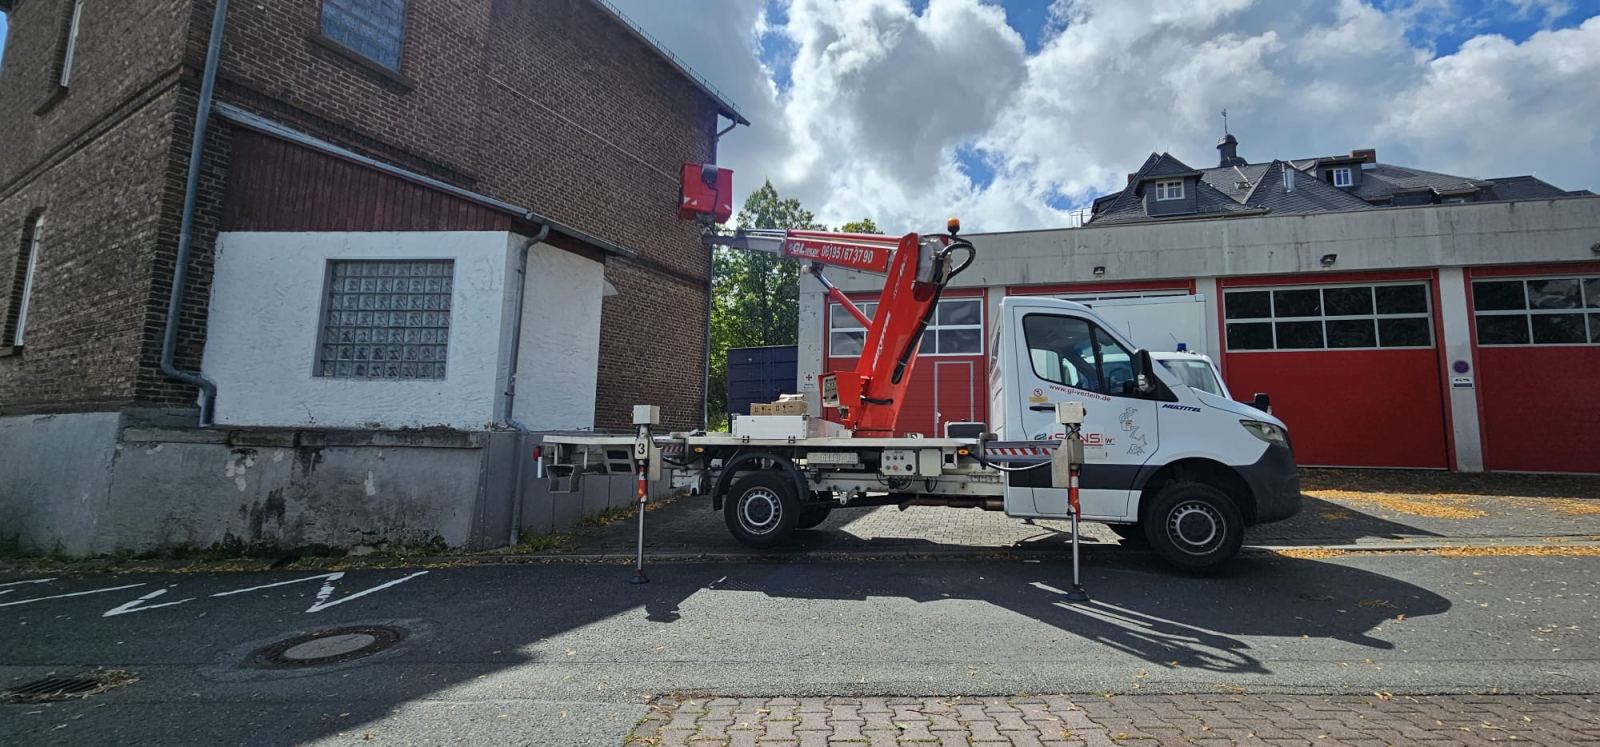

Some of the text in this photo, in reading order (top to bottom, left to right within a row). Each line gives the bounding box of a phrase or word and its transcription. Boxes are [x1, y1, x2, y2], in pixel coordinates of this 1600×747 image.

[1049, 384, 1111, 401] www.gl-verleih.de
[1162, 404, 1201, 412] MULTITEL
[1054, 432, 1101, 444] SNS
[638, 443, 645, 454] 3
